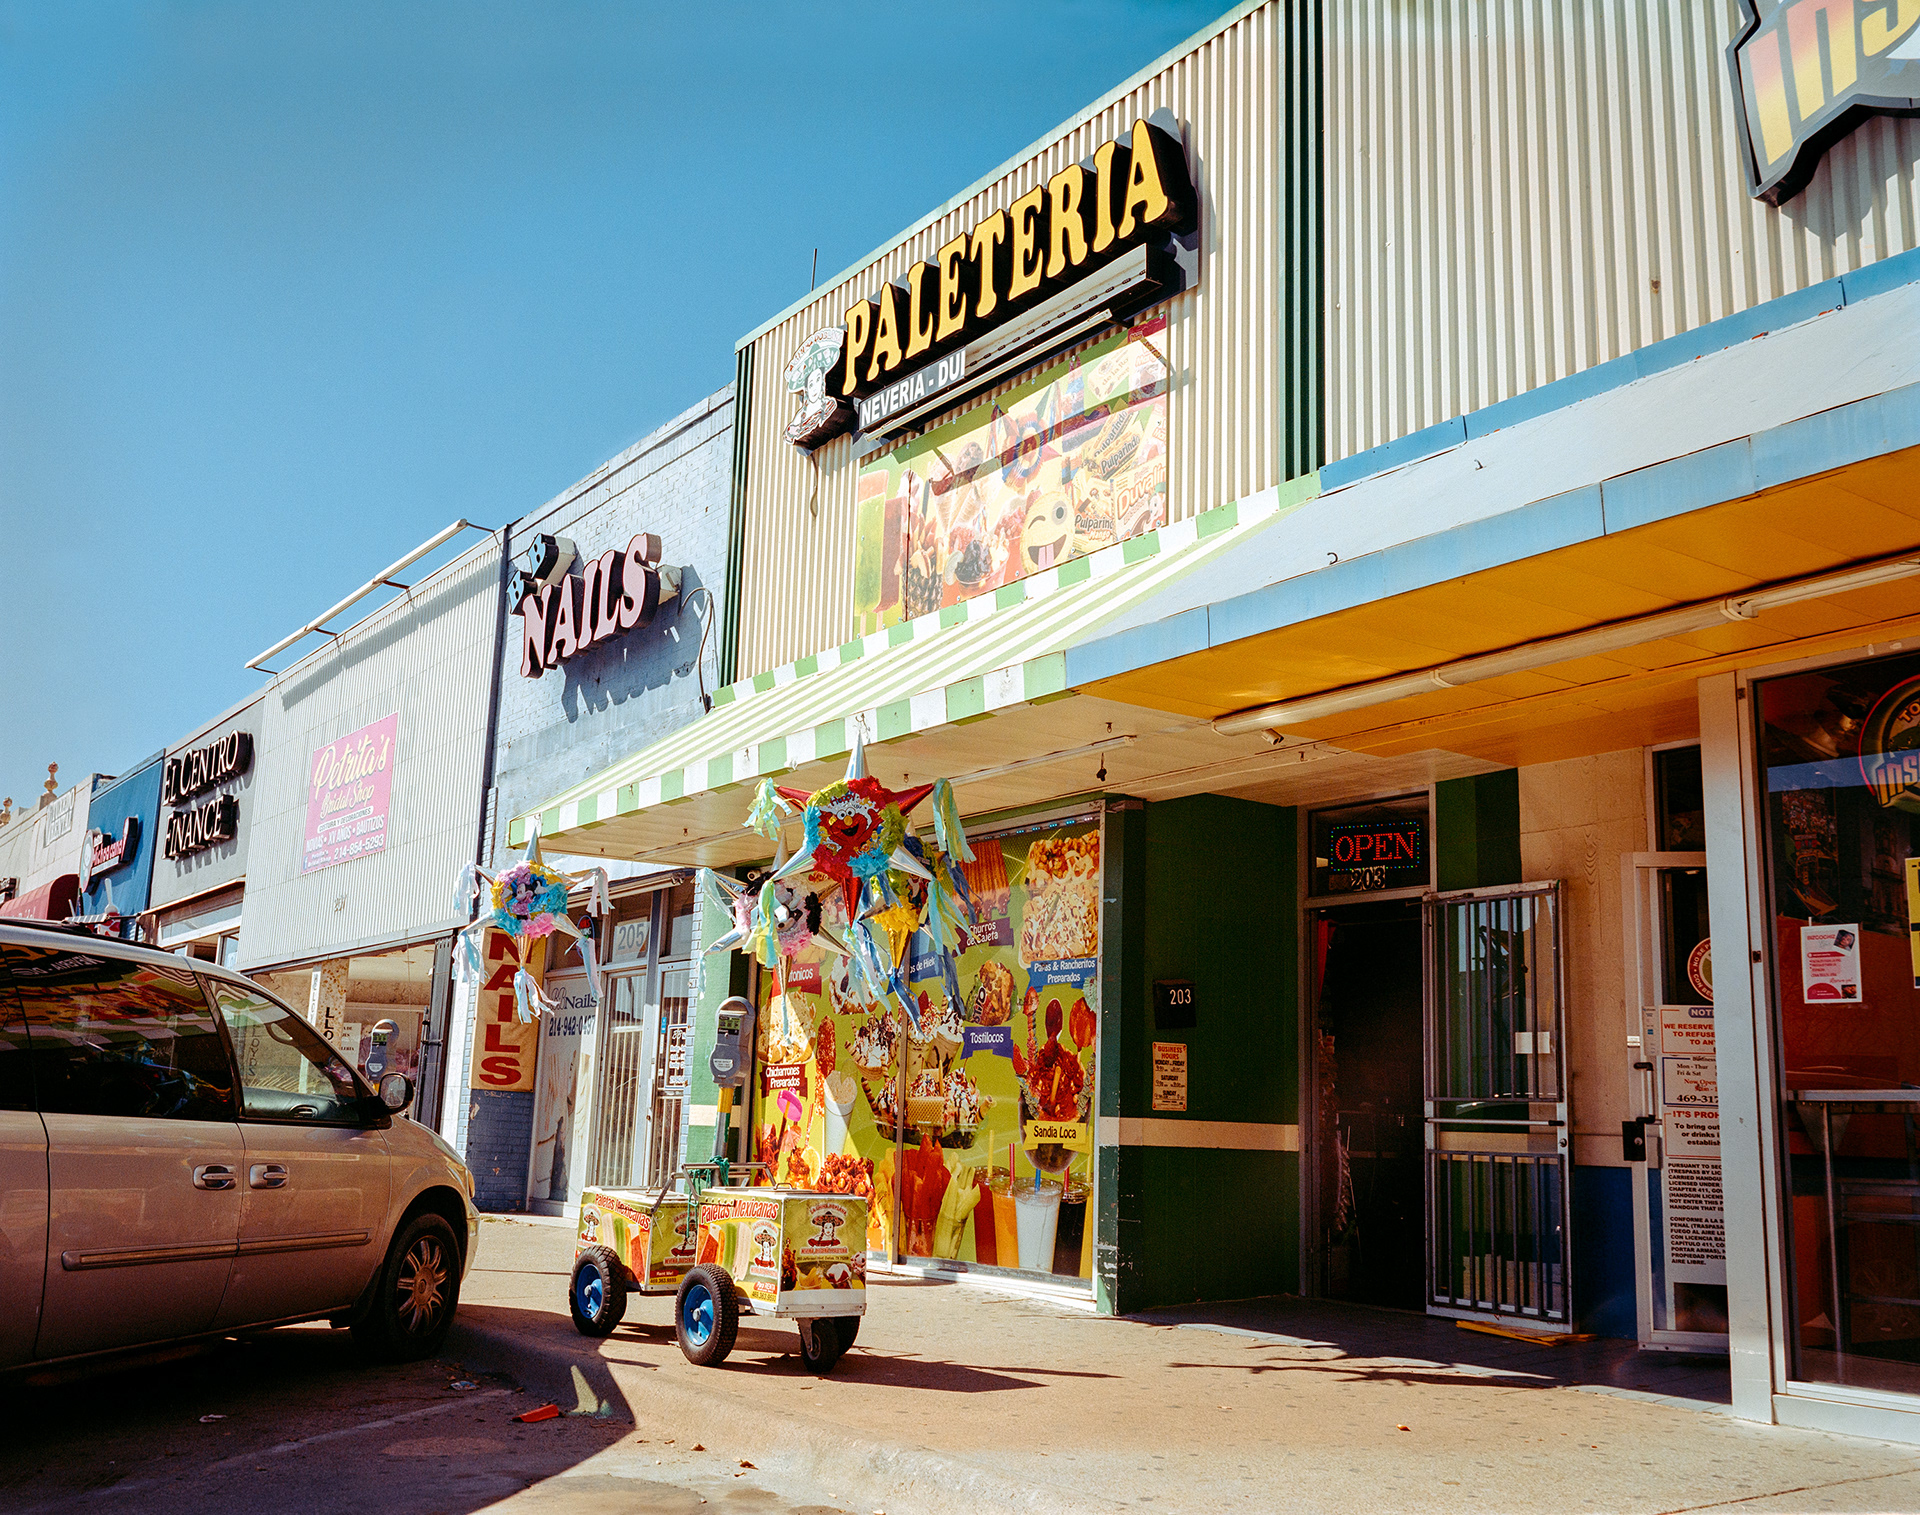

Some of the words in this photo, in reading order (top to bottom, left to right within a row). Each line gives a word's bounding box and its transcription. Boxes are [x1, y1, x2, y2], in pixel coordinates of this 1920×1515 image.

[842, 118, 1168, 396] PALETERIA
[861, 372, 925, 427] NEVERIA
[1101, 435, 1140, 474] Pulparindo
[520, 532, 648, 678] NAILS
[163, 760, 177, 806] EL
[180, 730, 239, 796] CENTRO
[313, 734, 391, 802] Petrita's
[320, 787, 349, 820] Bridal
[349, 779, 375, 808] Shop
[162, 796, 223, 860] FINANCE
[356, 814, 385, 837] BAUTIZOS
[334, 833, 385, 861] 214-854-5293
[1335, 832, 1416, 861] OPEN
[1351, 867, 1385, 891] 203
[618, 924, 645, 950] 205
[1047, 972, 1080, 983] Preparados
[1052, 961, 1059, 971] &
[564, 994, 597, 1010] Nails
[1169, 988, 1191, 1005] 203
[1691, 1009, 1714, 1017] NOT
[970, 1031, 1004, 1043] Tostilocos
[1033, 1125, 1058, 1139] Sandia
[1059, 1126, 1076, 1139] Loca
[1686, 1123, 1706, 1131] bring
[595, 1193, 616, 1211] Paletas
[701, 1201, 730, 1225] Paletas
[731, 1198, 779, 1220] Mexicanas
